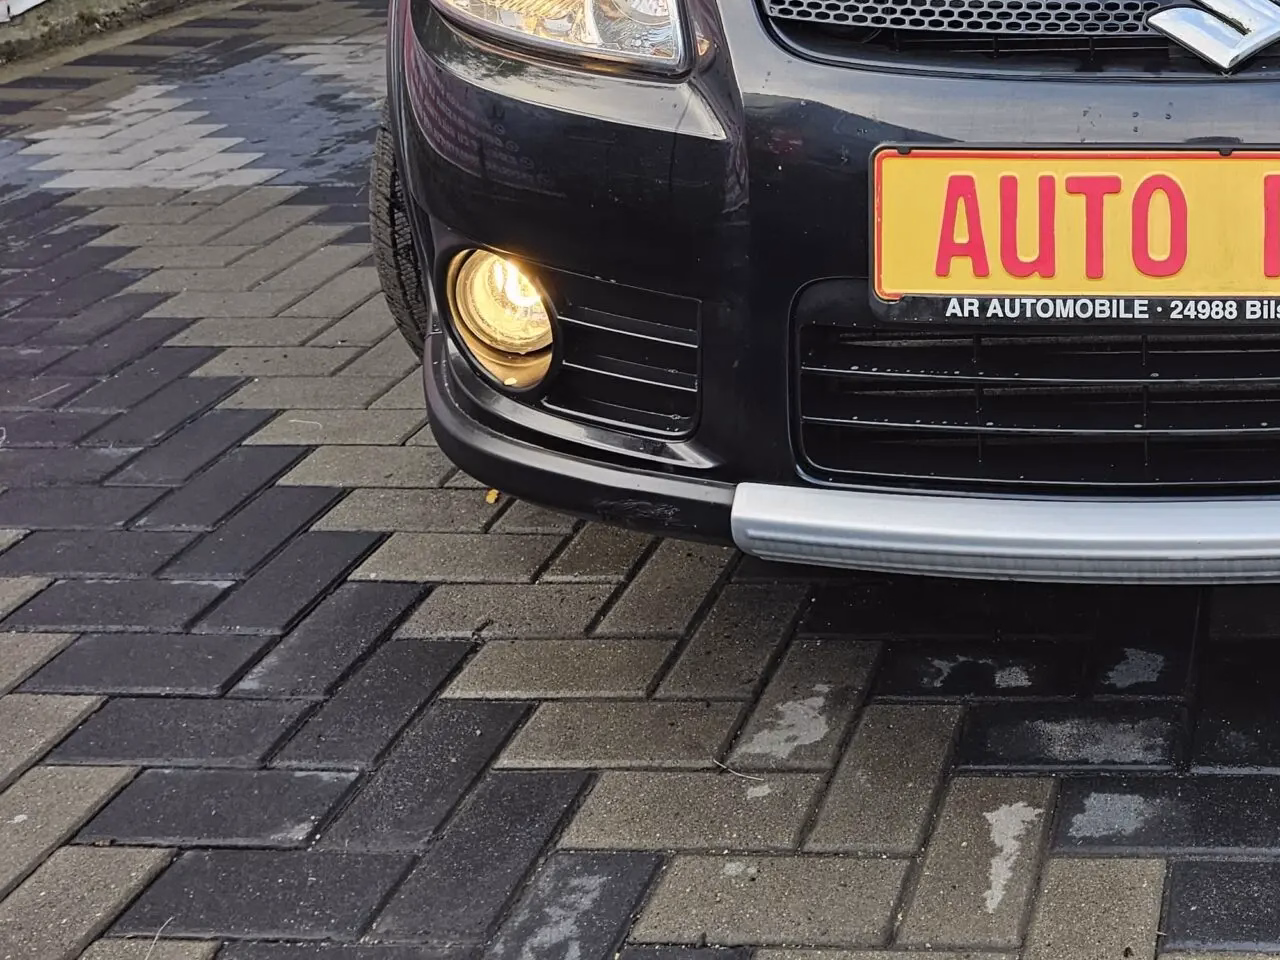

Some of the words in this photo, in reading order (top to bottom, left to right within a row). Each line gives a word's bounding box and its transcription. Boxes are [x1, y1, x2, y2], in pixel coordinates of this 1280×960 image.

[935, 174, 1188, 279] AUTO
[945, 297, 980, 318] AR
[986, 298, 1149, 319] AUTOMOBILE
[1169, 300, 1238, 321] 24988
